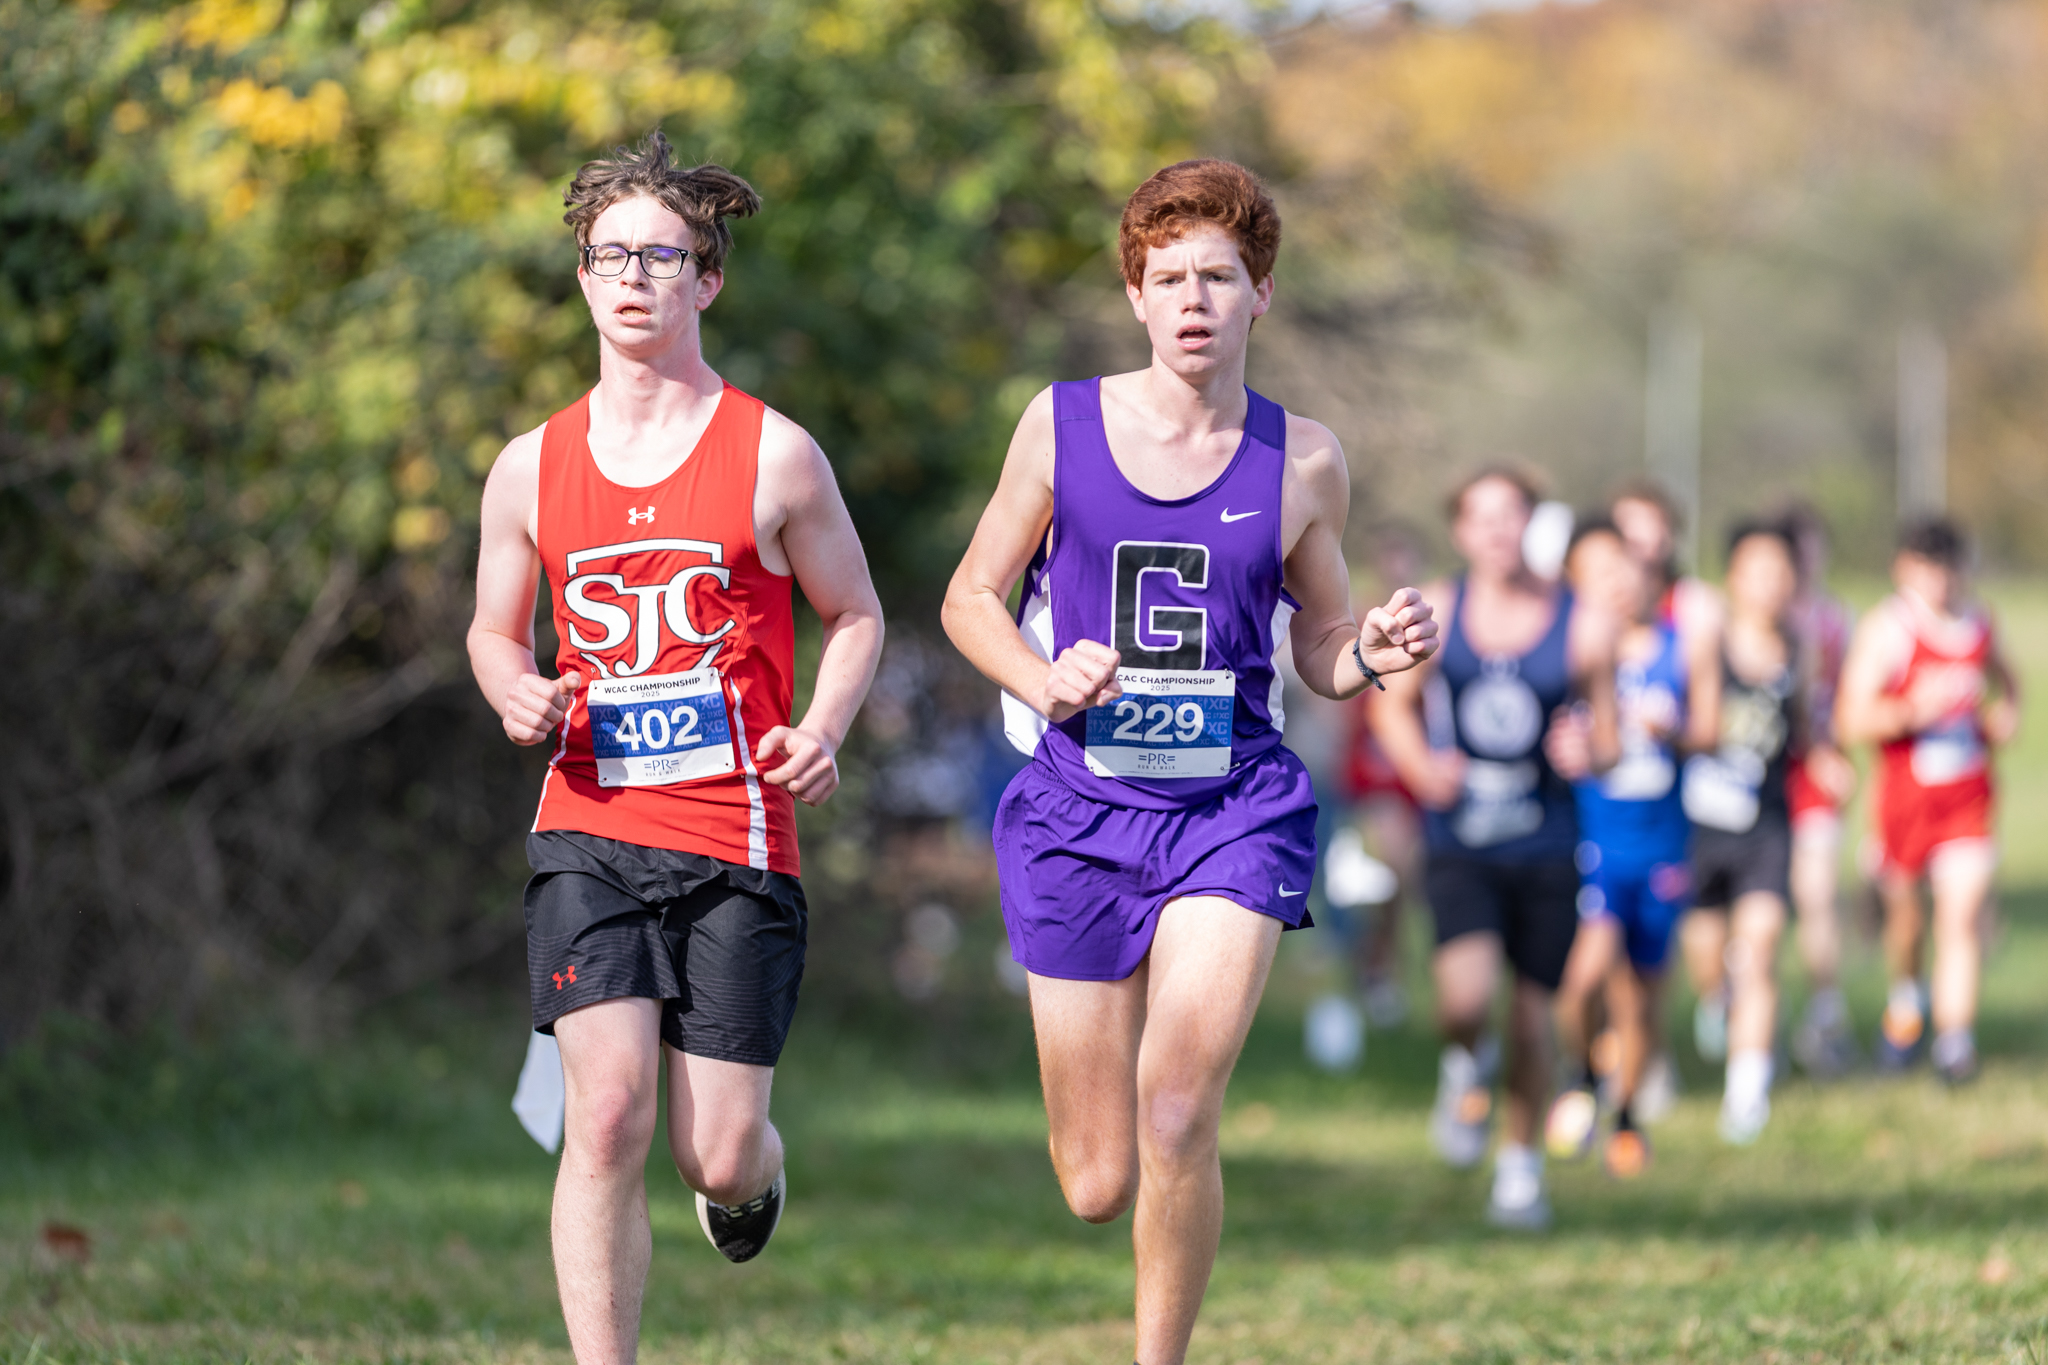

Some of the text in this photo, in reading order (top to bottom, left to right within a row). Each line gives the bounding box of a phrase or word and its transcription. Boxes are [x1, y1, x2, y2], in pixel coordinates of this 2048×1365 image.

[563, 565, 736, 677] SJC
[1110, 540, 1210, 671] G
[604, 677, 701, 694] WCAC CHAMPIONSHIP
[1117, 674, 1215, 685] CAC CHAMPIONSHIP
[615, 705, 702, 751] 402
[1113, 700, 1204, 742] 229
